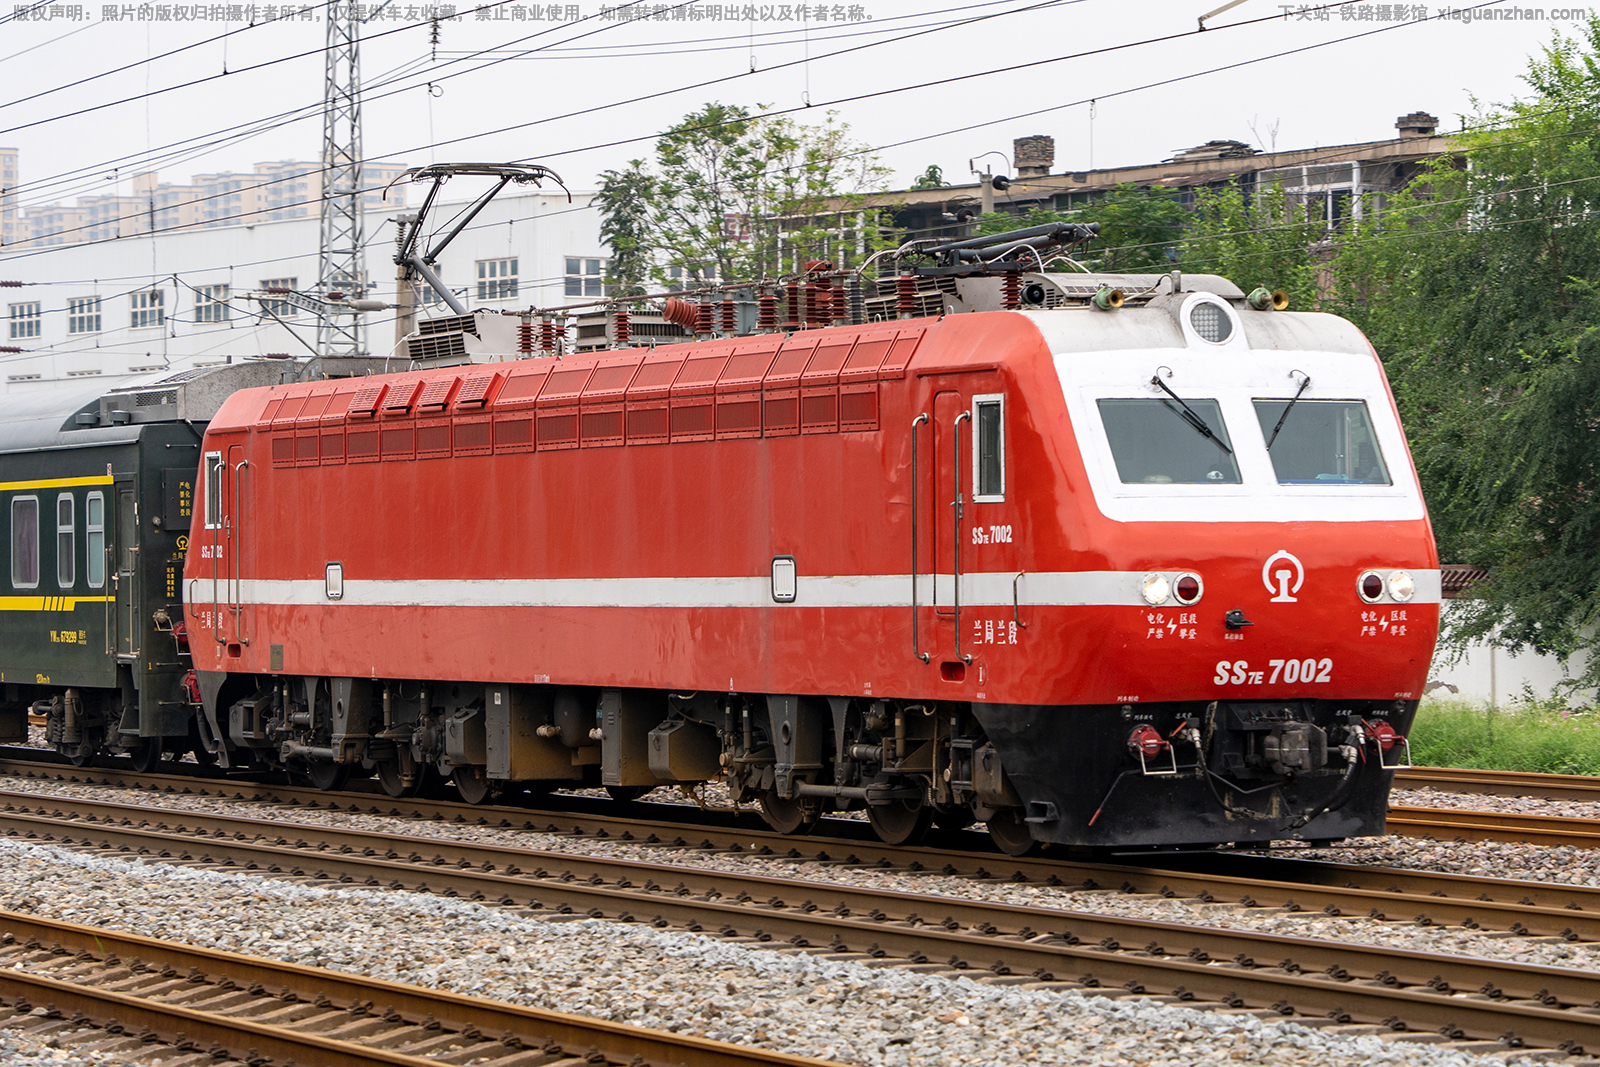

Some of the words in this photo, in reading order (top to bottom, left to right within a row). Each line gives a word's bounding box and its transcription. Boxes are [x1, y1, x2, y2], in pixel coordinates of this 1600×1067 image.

[990, 525, 1013, 544] 7002
[210, 545, 223, 559] 702
[1213, 660, 1264, 686] SS7E
[1268, 658, 1333, 684] 7002
